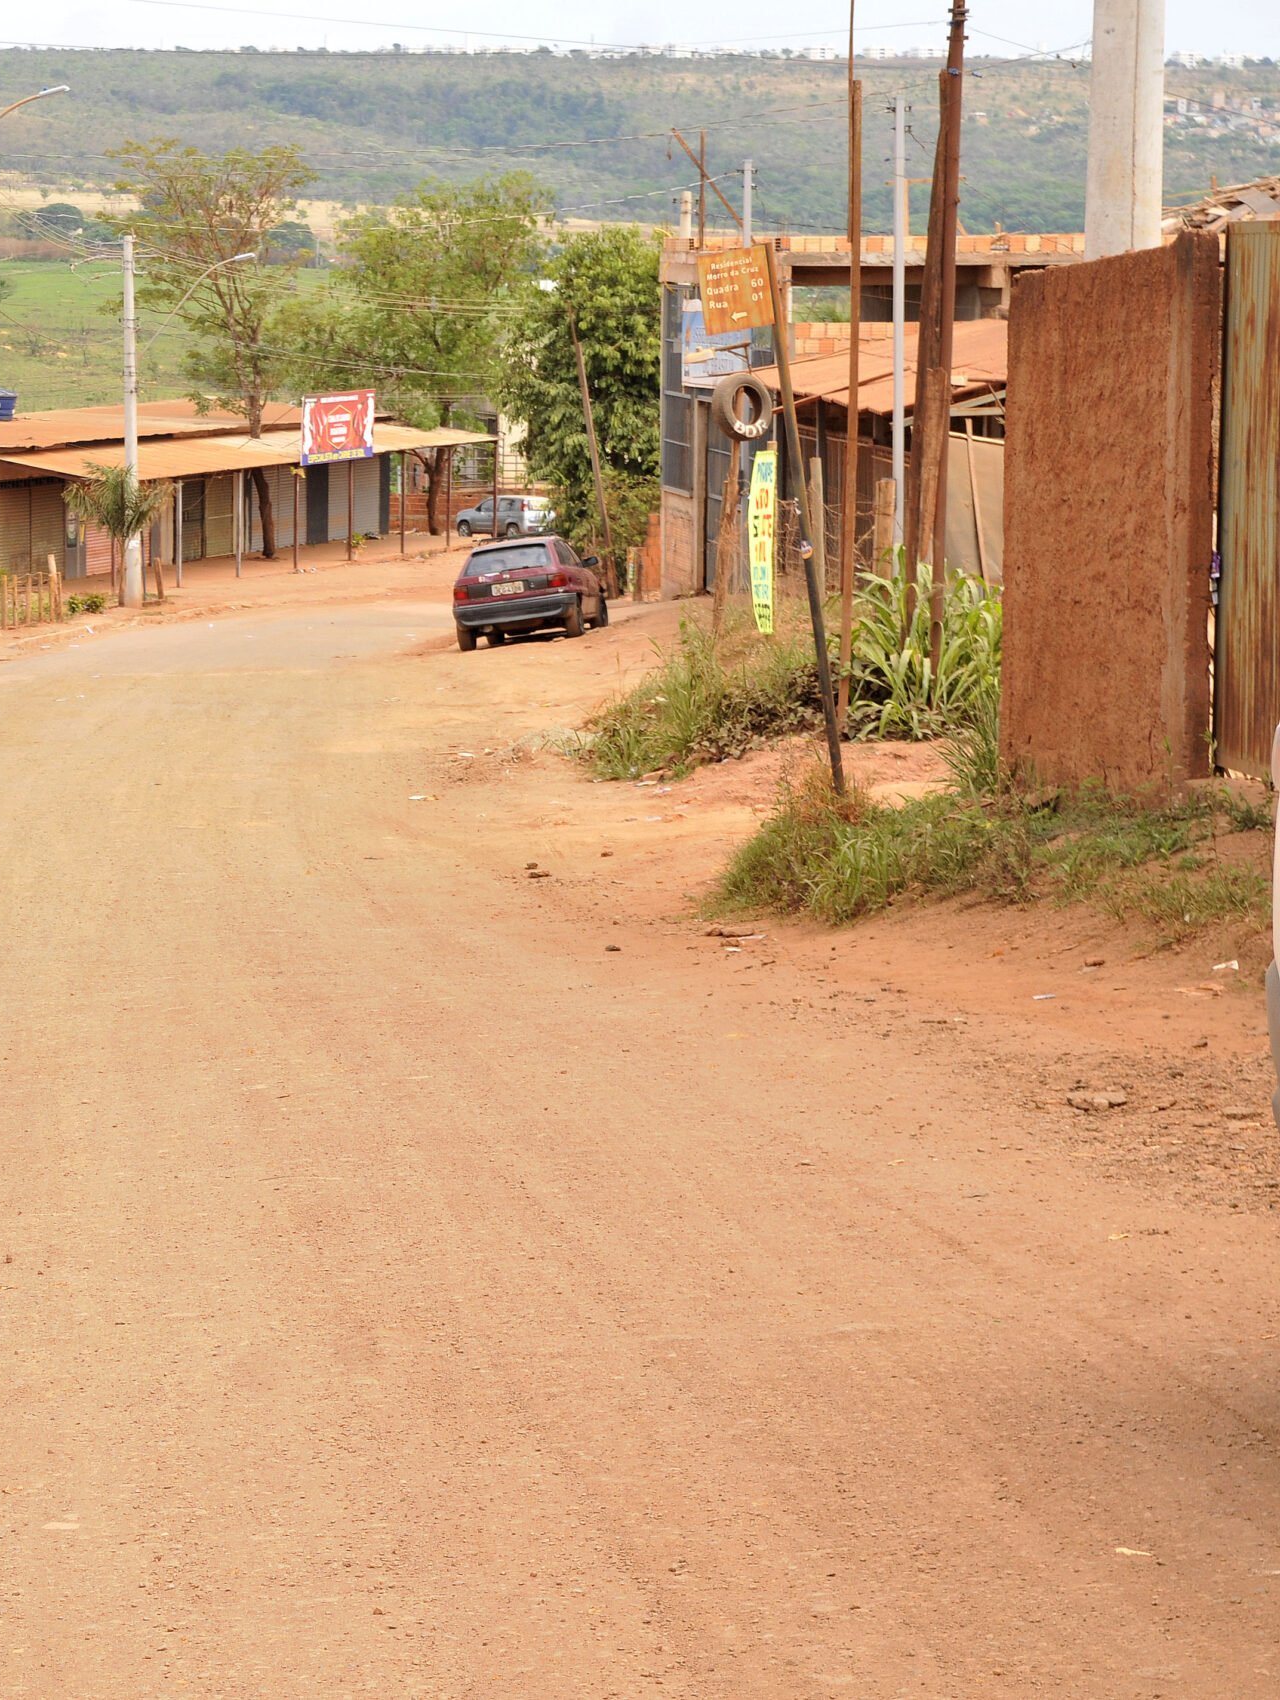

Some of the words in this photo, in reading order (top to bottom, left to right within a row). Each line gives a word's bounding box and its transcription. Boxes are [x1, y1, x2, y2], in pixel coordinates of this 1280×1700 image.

[711, 257, 752, 270] Residencial
[706, 271, 728, 281] Morro
[730, 269, 739, 277] da
[741, 265, 759, 274] Cruz
[706, 284, 739, 296] Quadra
[751, 278, 764, 288] 60
[709, 300, 728, 309] Rua
[751, 291, 764, 302] 01
